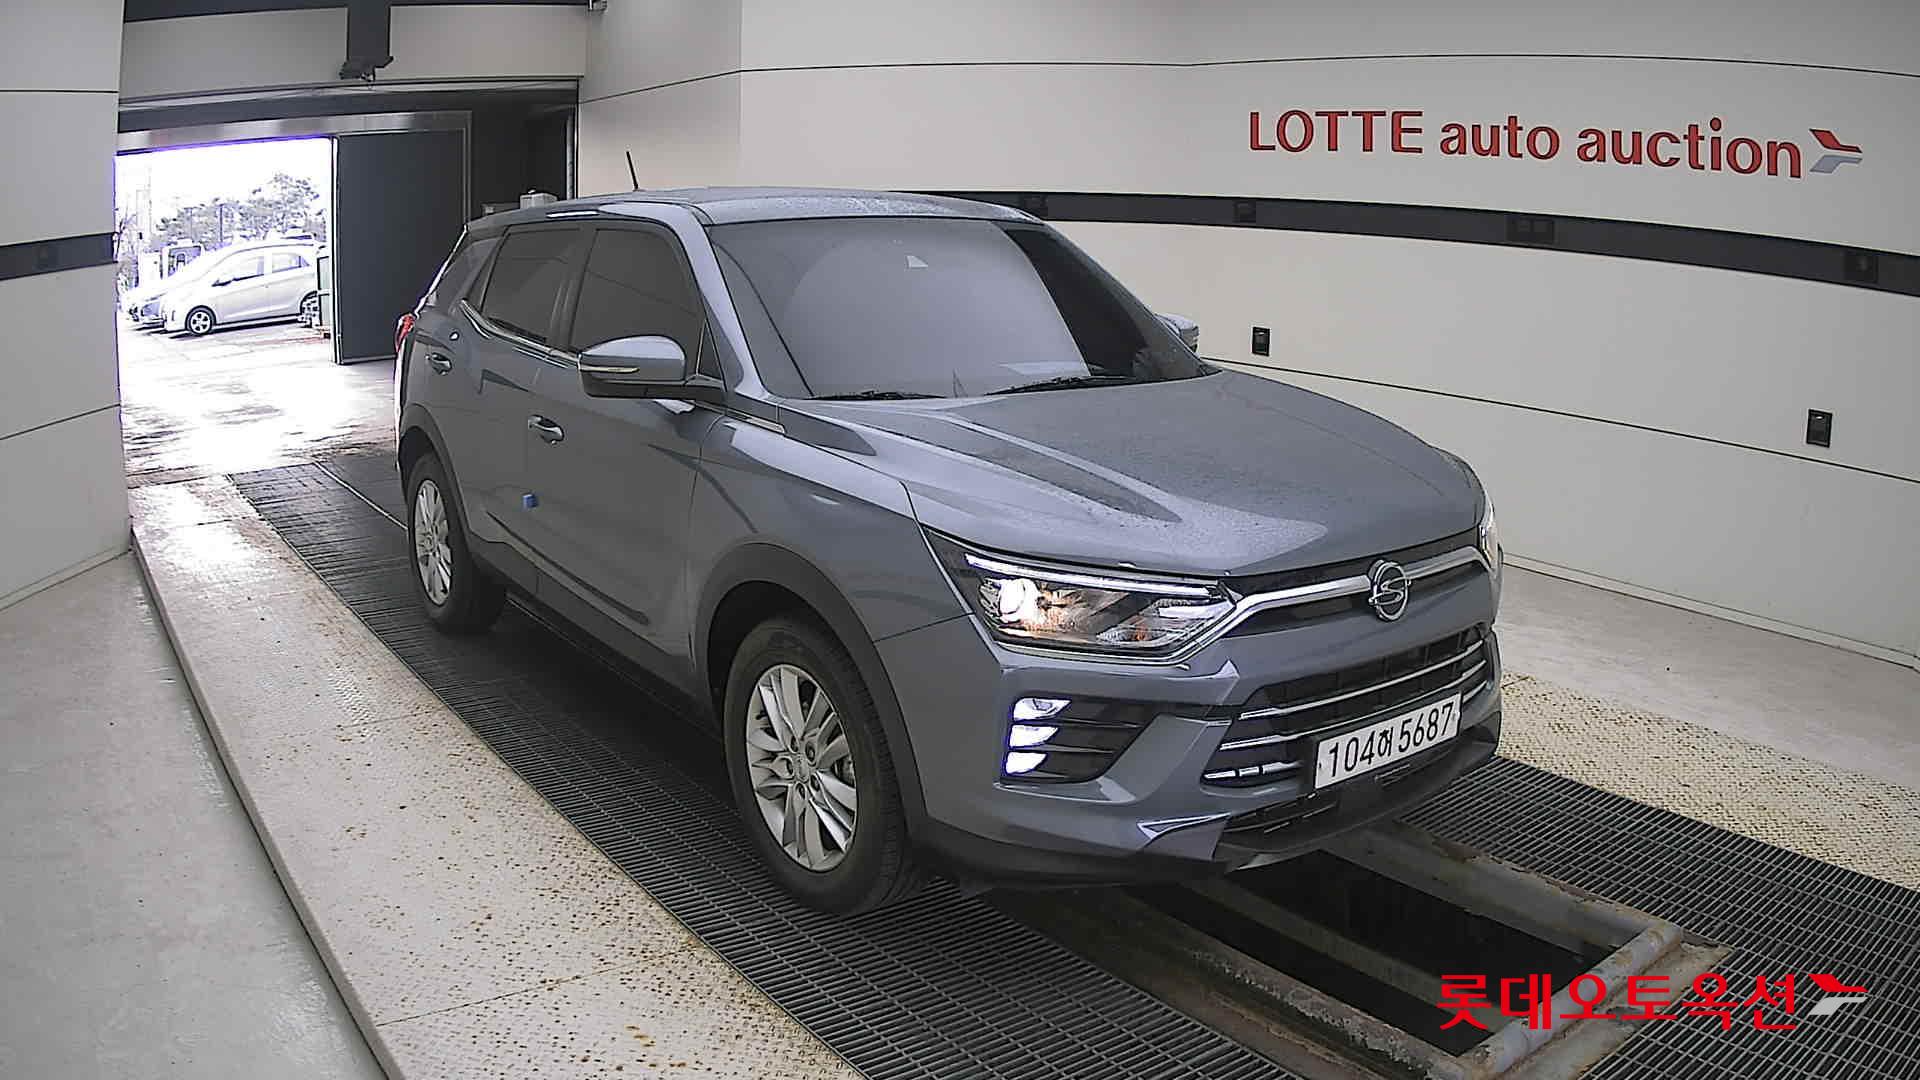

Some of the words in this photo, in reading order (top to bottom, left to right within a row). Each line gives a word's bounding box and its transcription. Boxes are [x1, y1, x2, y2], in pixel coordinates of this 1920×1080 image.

[1249, 110, 1424, 154] LOTTE
[1440, 115, 1560, 160] auto
[1577, 118, 1802, 178] auction
[1399, 701, 1455, 752] 5687
